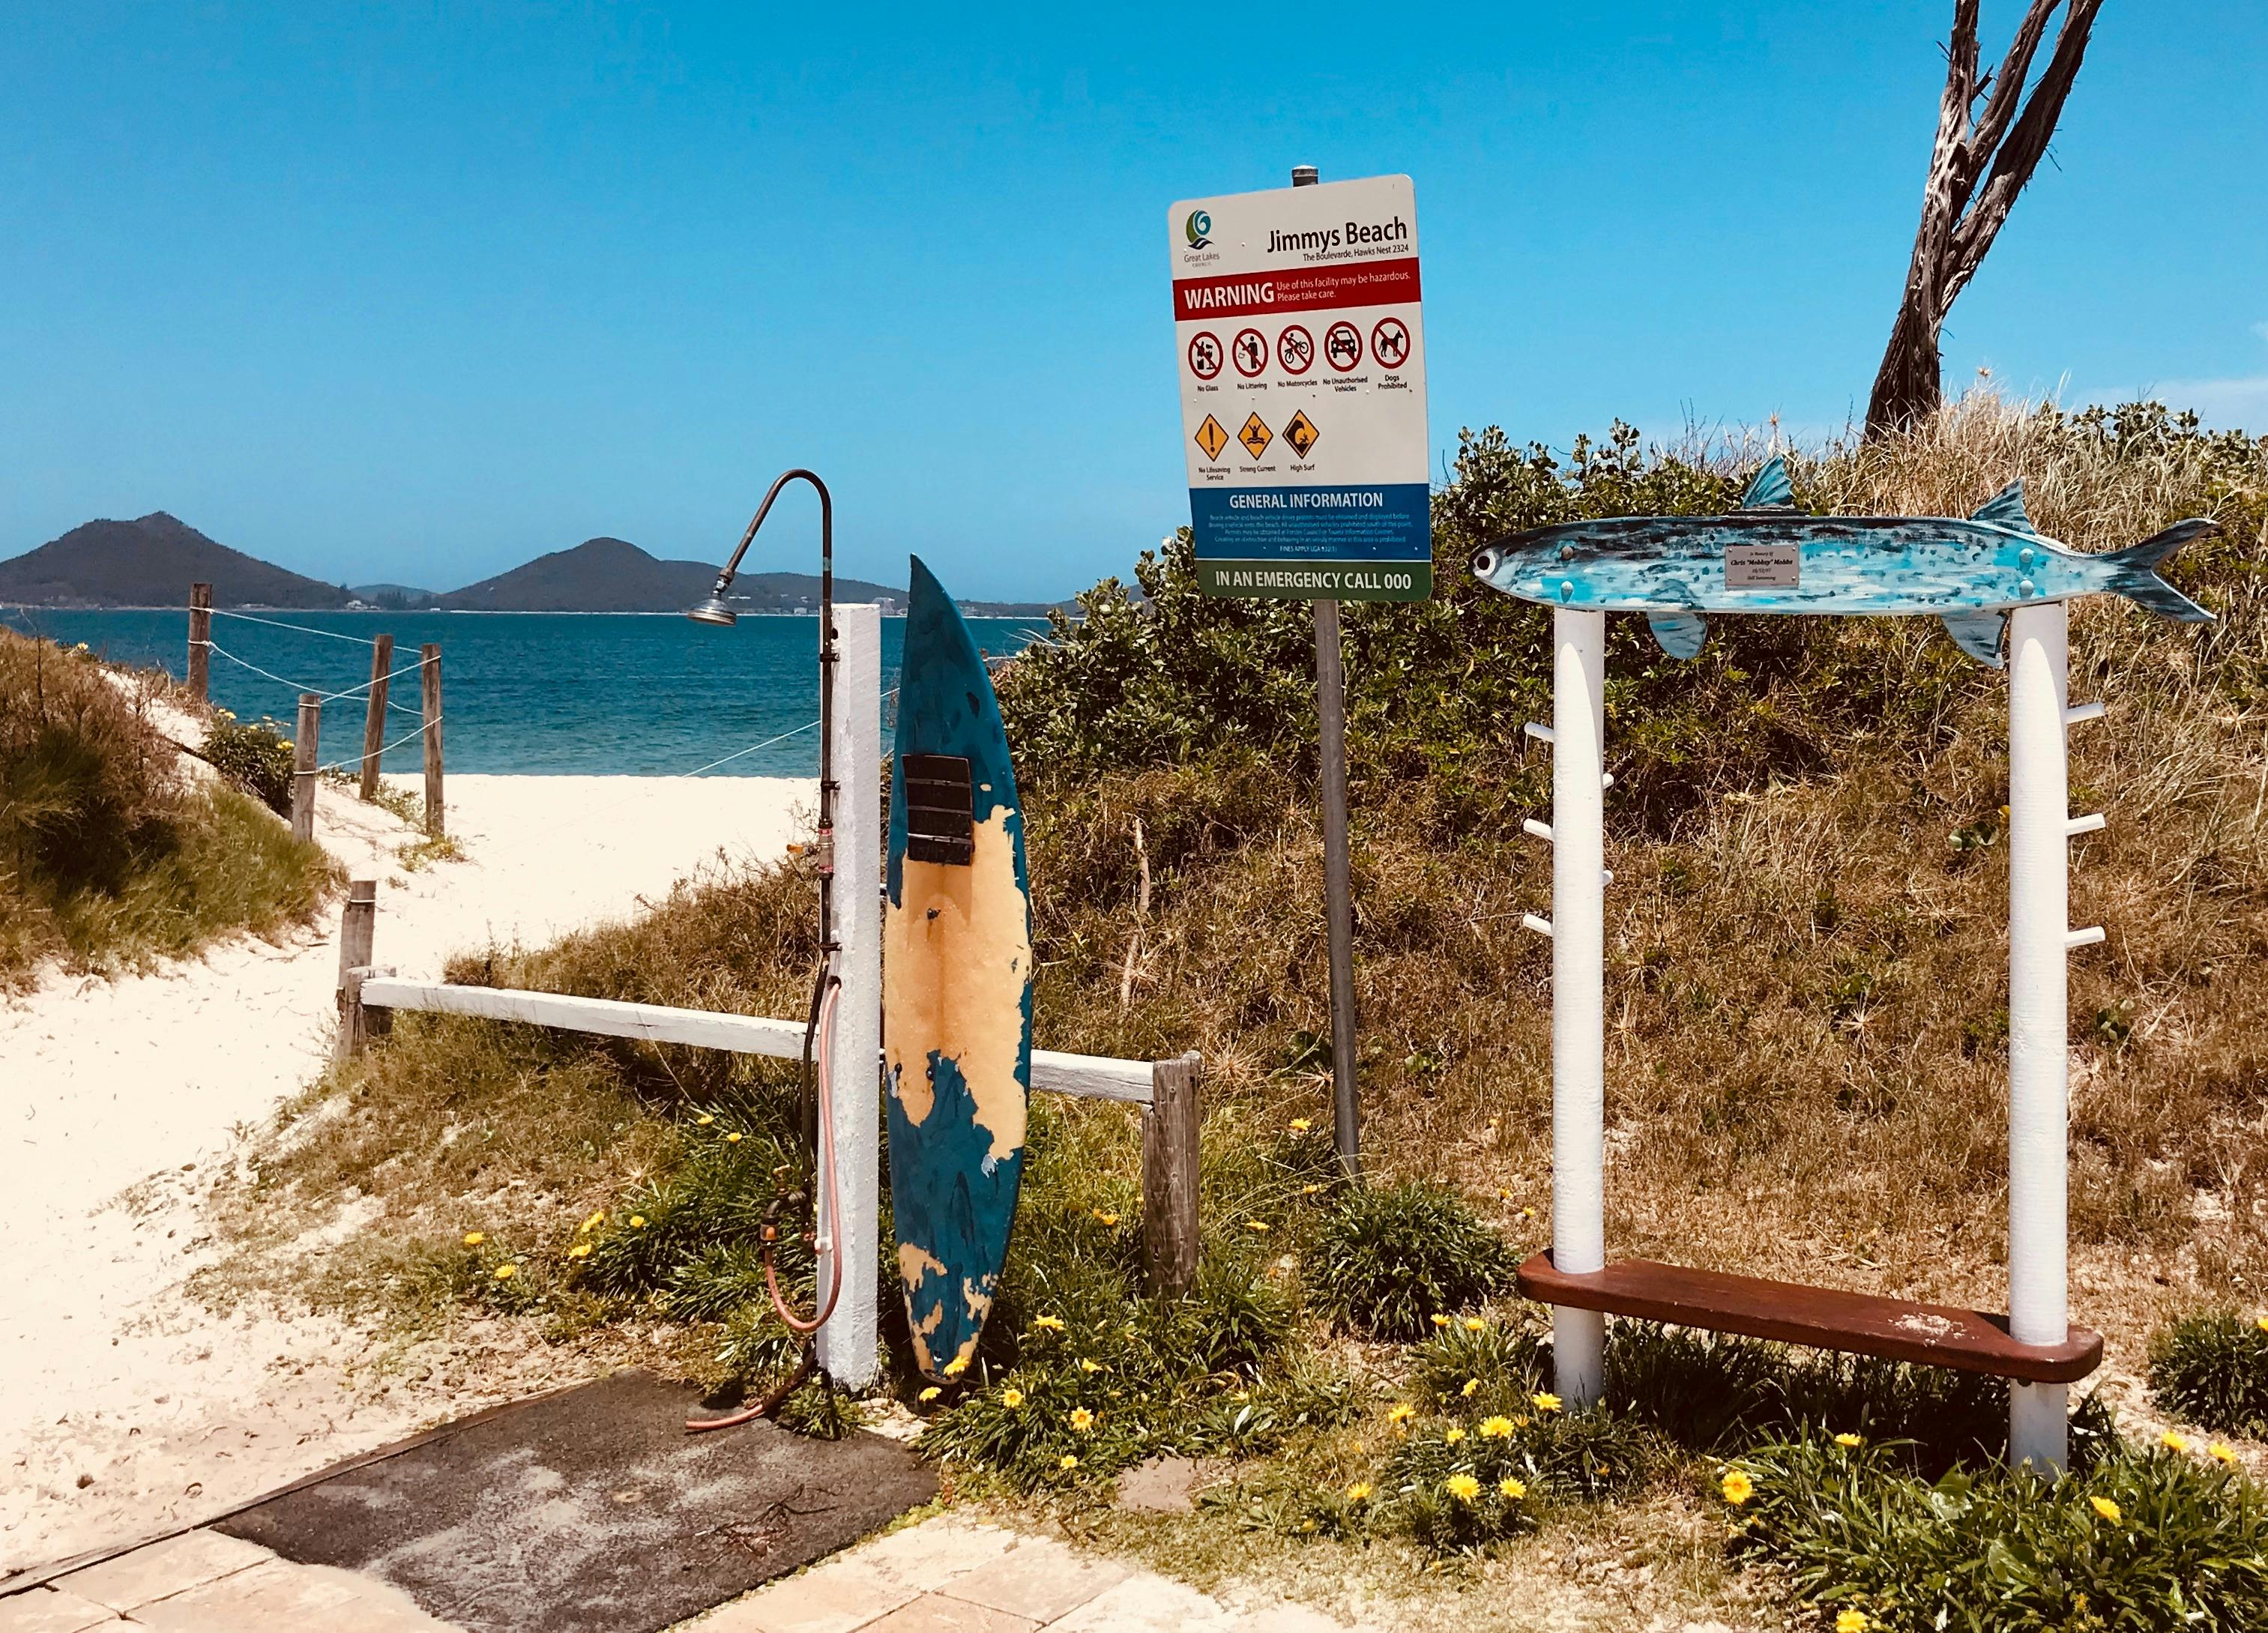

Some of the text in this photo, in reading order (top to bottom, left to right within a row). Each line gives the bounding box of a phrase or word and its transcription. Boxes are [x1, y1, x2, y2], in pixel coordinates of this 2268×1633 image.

[1267, 216, 1407, 253] Jimmys Beach
[1184, 252, 1220, 263] Great Lakes
[1303, 244, 1408, 262] The Boulevarde, Hawks Nest 2324
[1276, 271, 1411, 291] Use of this facility may be hazardous.
[1184, 282, 1274, 309] WARNING
[1277, 290, 1336, 302] Please take care.
[1286, 379, 1318, 387] Motorcycles
[1384, 374, 1399, 382] Dogs
[1245, 381, 1267, 390] Littering
[1334, 384, 1357, 393] Vehicles
[1378, 381, 1407, 390] Prohibited
[1239, 465, 1256, 474] Strong
[1290, 463, 1315, 472] High Surf
[1229, 492, 1383, 509] GENERAL INFORMATION
[1216, 570, 1411, 590] IN AN EMERGENCY CALL 000
